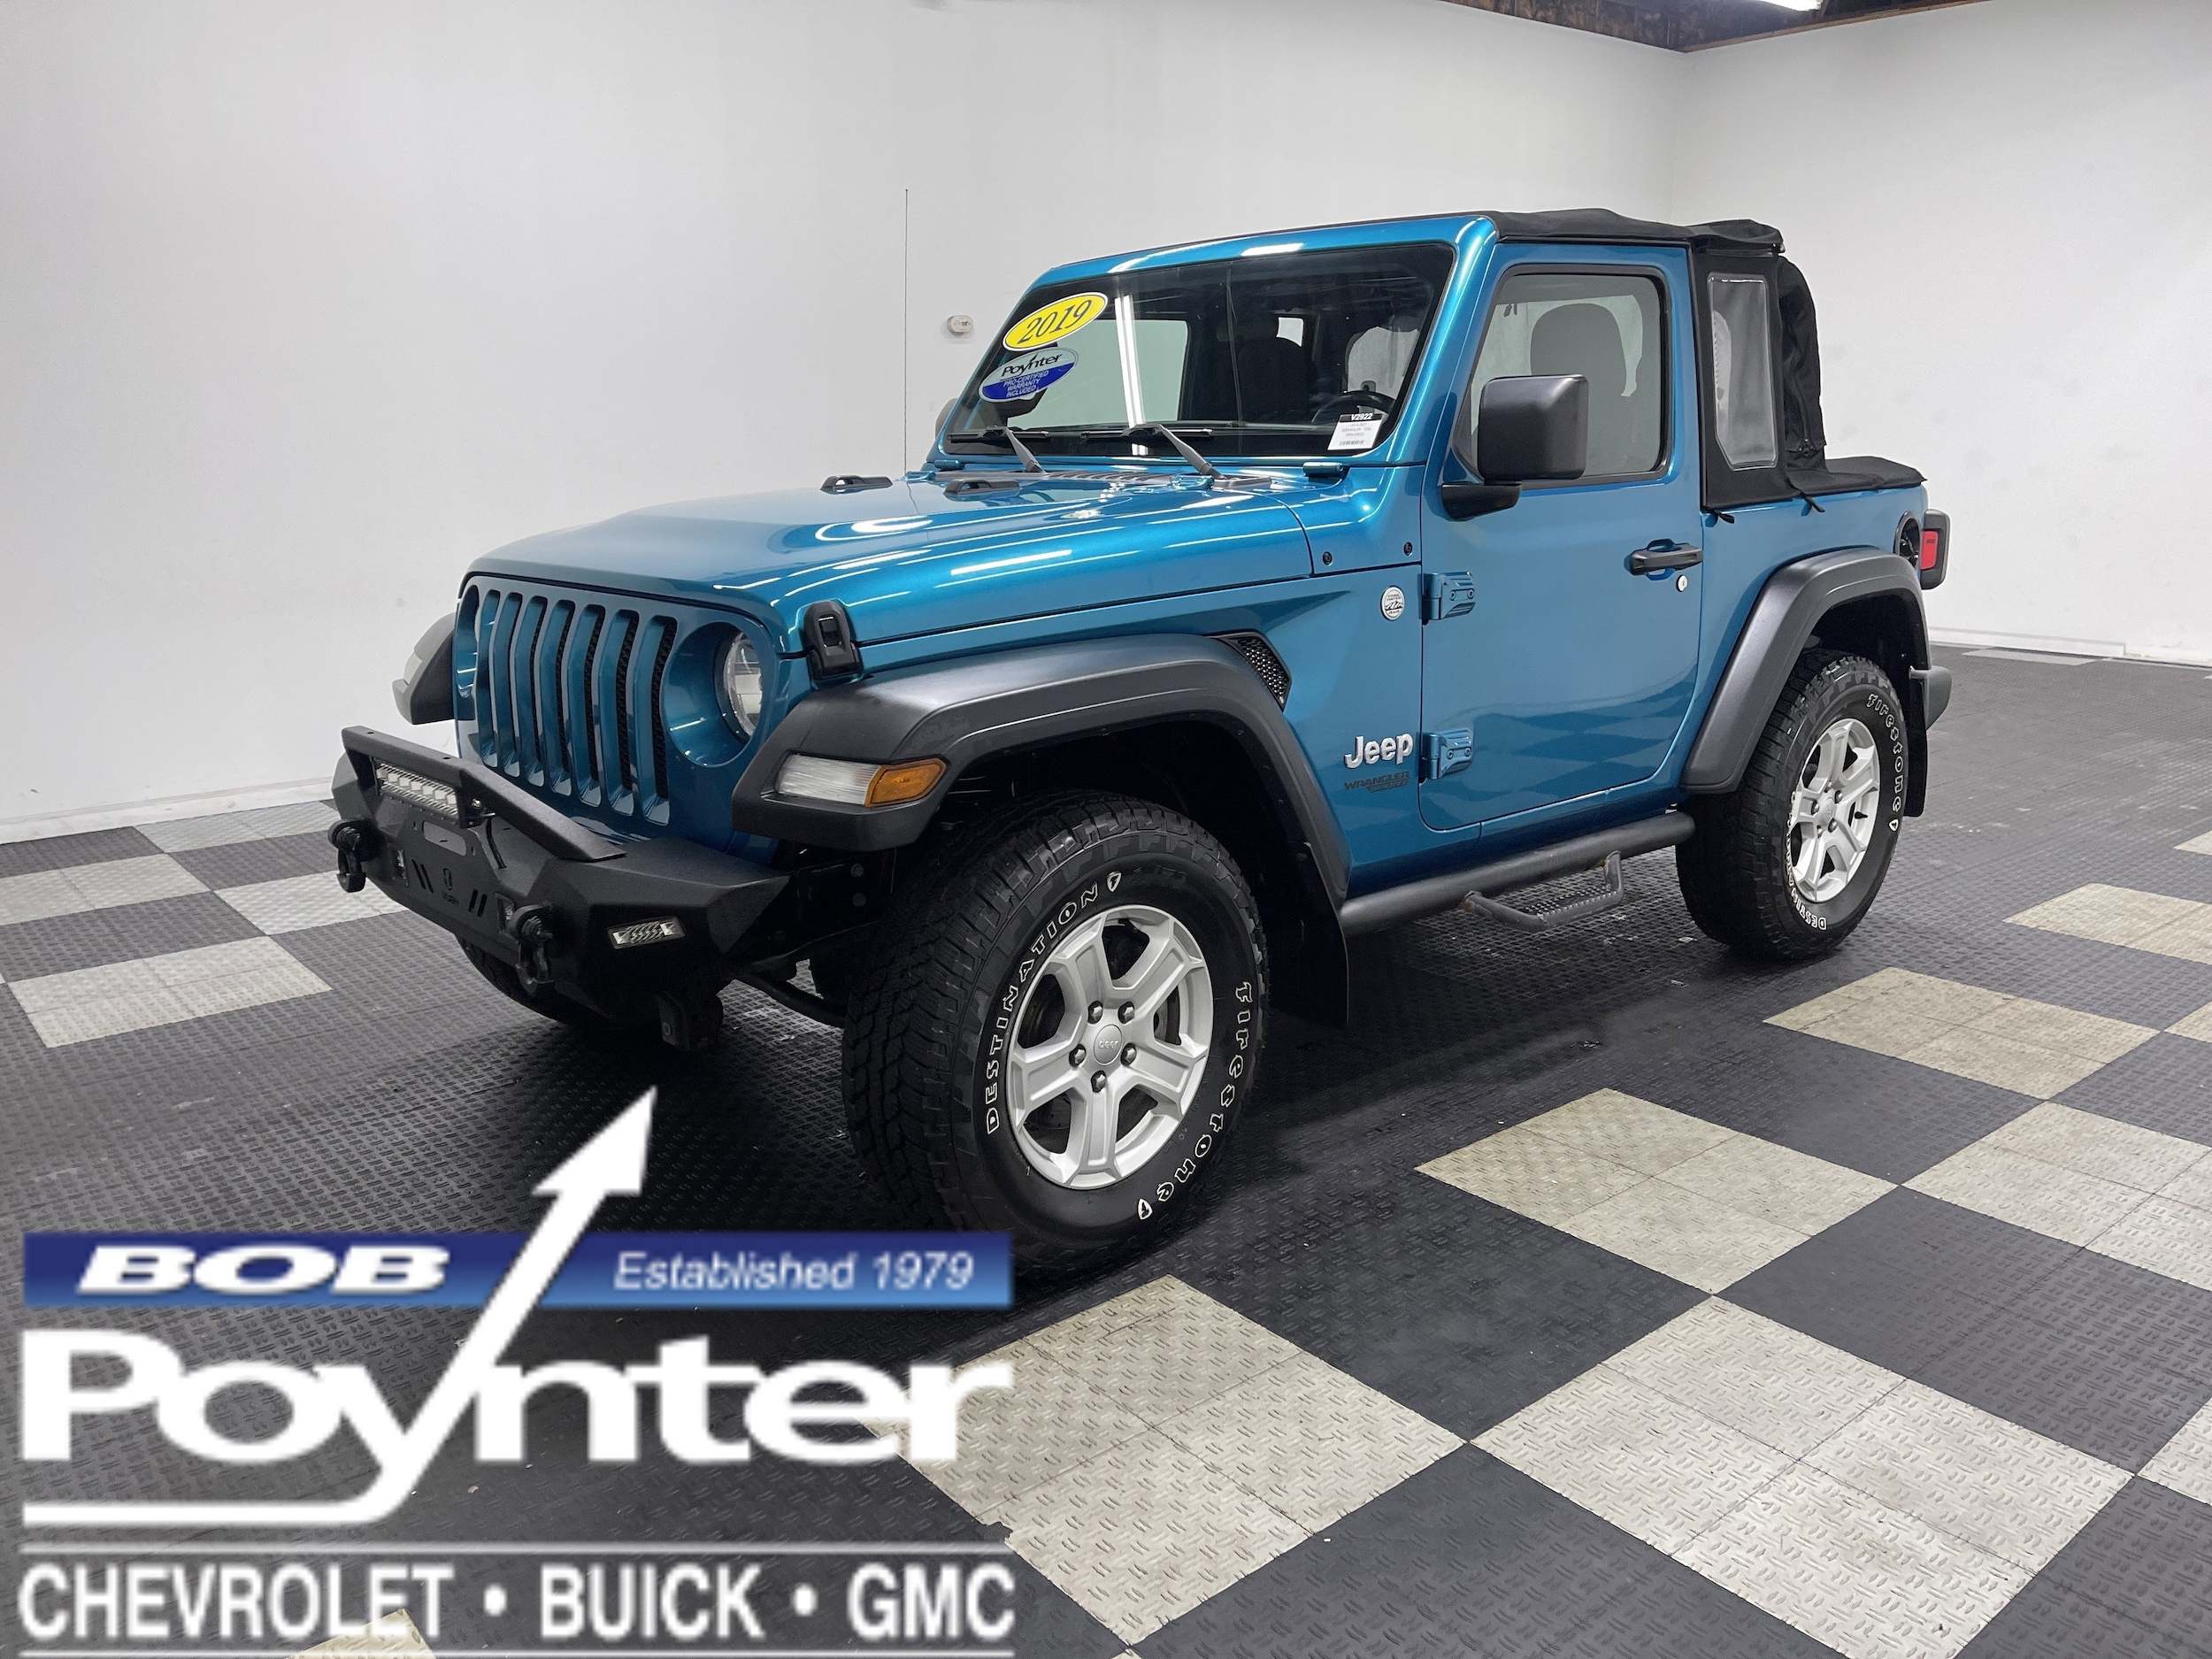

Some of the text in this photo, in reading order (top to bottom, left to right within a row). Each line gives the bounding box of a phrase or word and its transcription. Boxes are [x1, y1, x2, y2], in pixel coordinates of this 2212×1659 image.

[1017, 299, 1093, 344] 2019
[1001, 353, 1063, 377] Poynter
[1006, 384, 1036, 397] INCLUDED
[1007, 378, 1041, 392] WARRANTY
[1344, 733, 1414, 769] Jeep
[1344, 771, 1409, 790] WRANGLER
[986, 883, 1098, 1134] DESTINATION
